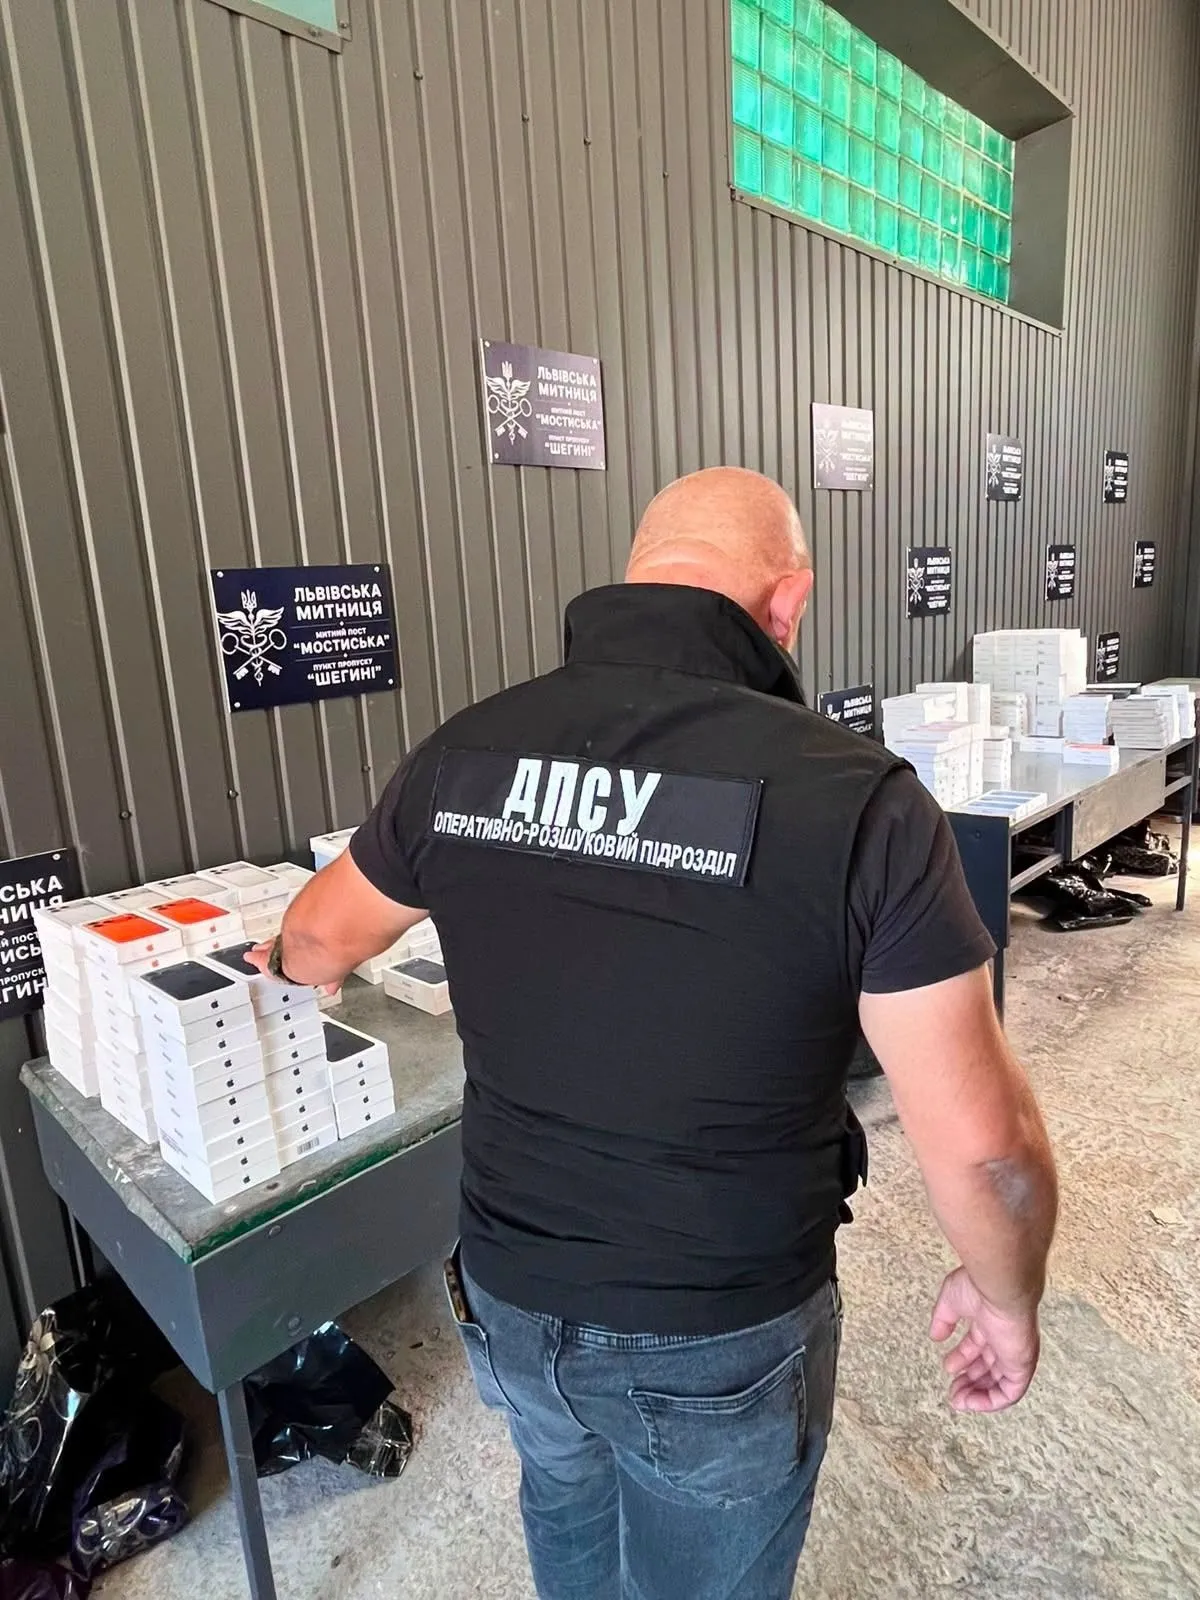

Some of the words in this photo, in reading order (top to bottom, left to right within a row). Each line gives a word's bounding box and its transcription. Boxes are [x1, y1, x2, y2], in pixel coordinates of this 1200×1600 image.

[537, 366, 597, 387] ЛЬВІВСЬКА
[538, 382, 597, 404] МИТНИЦЯ
[294, 583, 382, 603] ЛЬВІВСЬКА
[296, 600, 383, 621] МИТНИЦЯ
[315, 628, 347, 639] МИТНИЙ
[347, 627, 367, 636] ПОСТ
[293, 634, 390, 655] “МОСТИСЬКА”
[313, 662, 336, 671] ПУНКТ
[337, 658, 373, 668] ПРОПУСКУ
[307, 665, 382, 686] “ШЕГИНІ”
[501, 757, 662, 837] ДПСУ
[433, 810, 638, 863] ОПЕРАТИВНО-РОЗШУКОВИЙ
[640, 840, 738, 878] ПІДРОЗДІЛ
[0, 943, 42, 965] ИСЬ
[0, 967, 44, 986] ПРОПУСК
[0, 977, 47, 1003] ГИН
